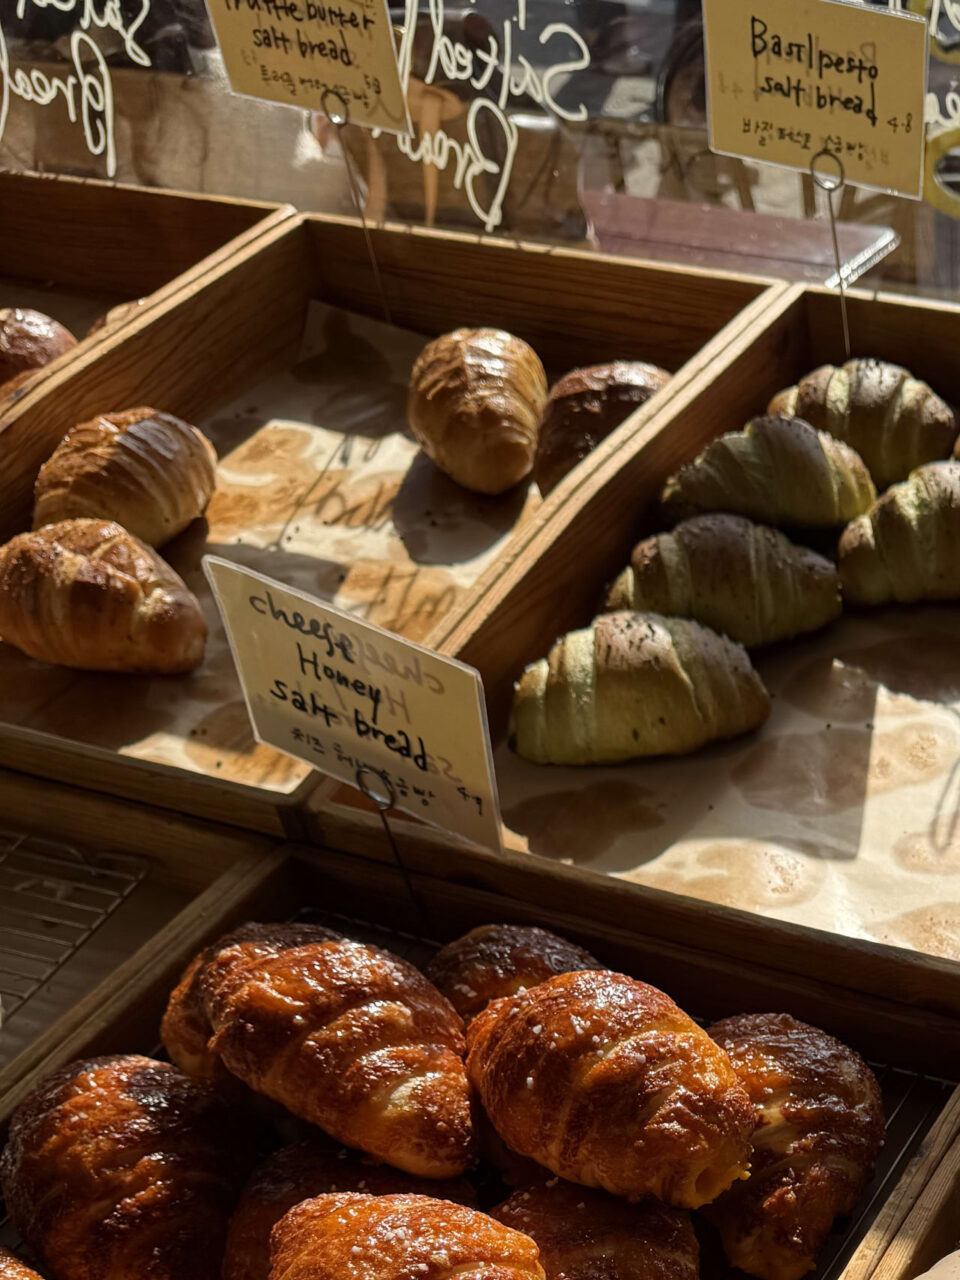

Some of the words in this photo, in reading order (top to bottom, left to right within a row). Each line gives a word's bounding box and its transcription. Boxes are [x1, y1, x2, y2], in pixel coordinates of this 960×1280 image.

[253, 26, 290, 55] salt
[296, 29, 353, 67] bread
[760, 76, 805, 107] salt
[816, 81, 878, 128] bread
[297, 642, 381, 725] Honey
[270, 680, 338, 728] salt
[355, 709, 428, 771] bread
